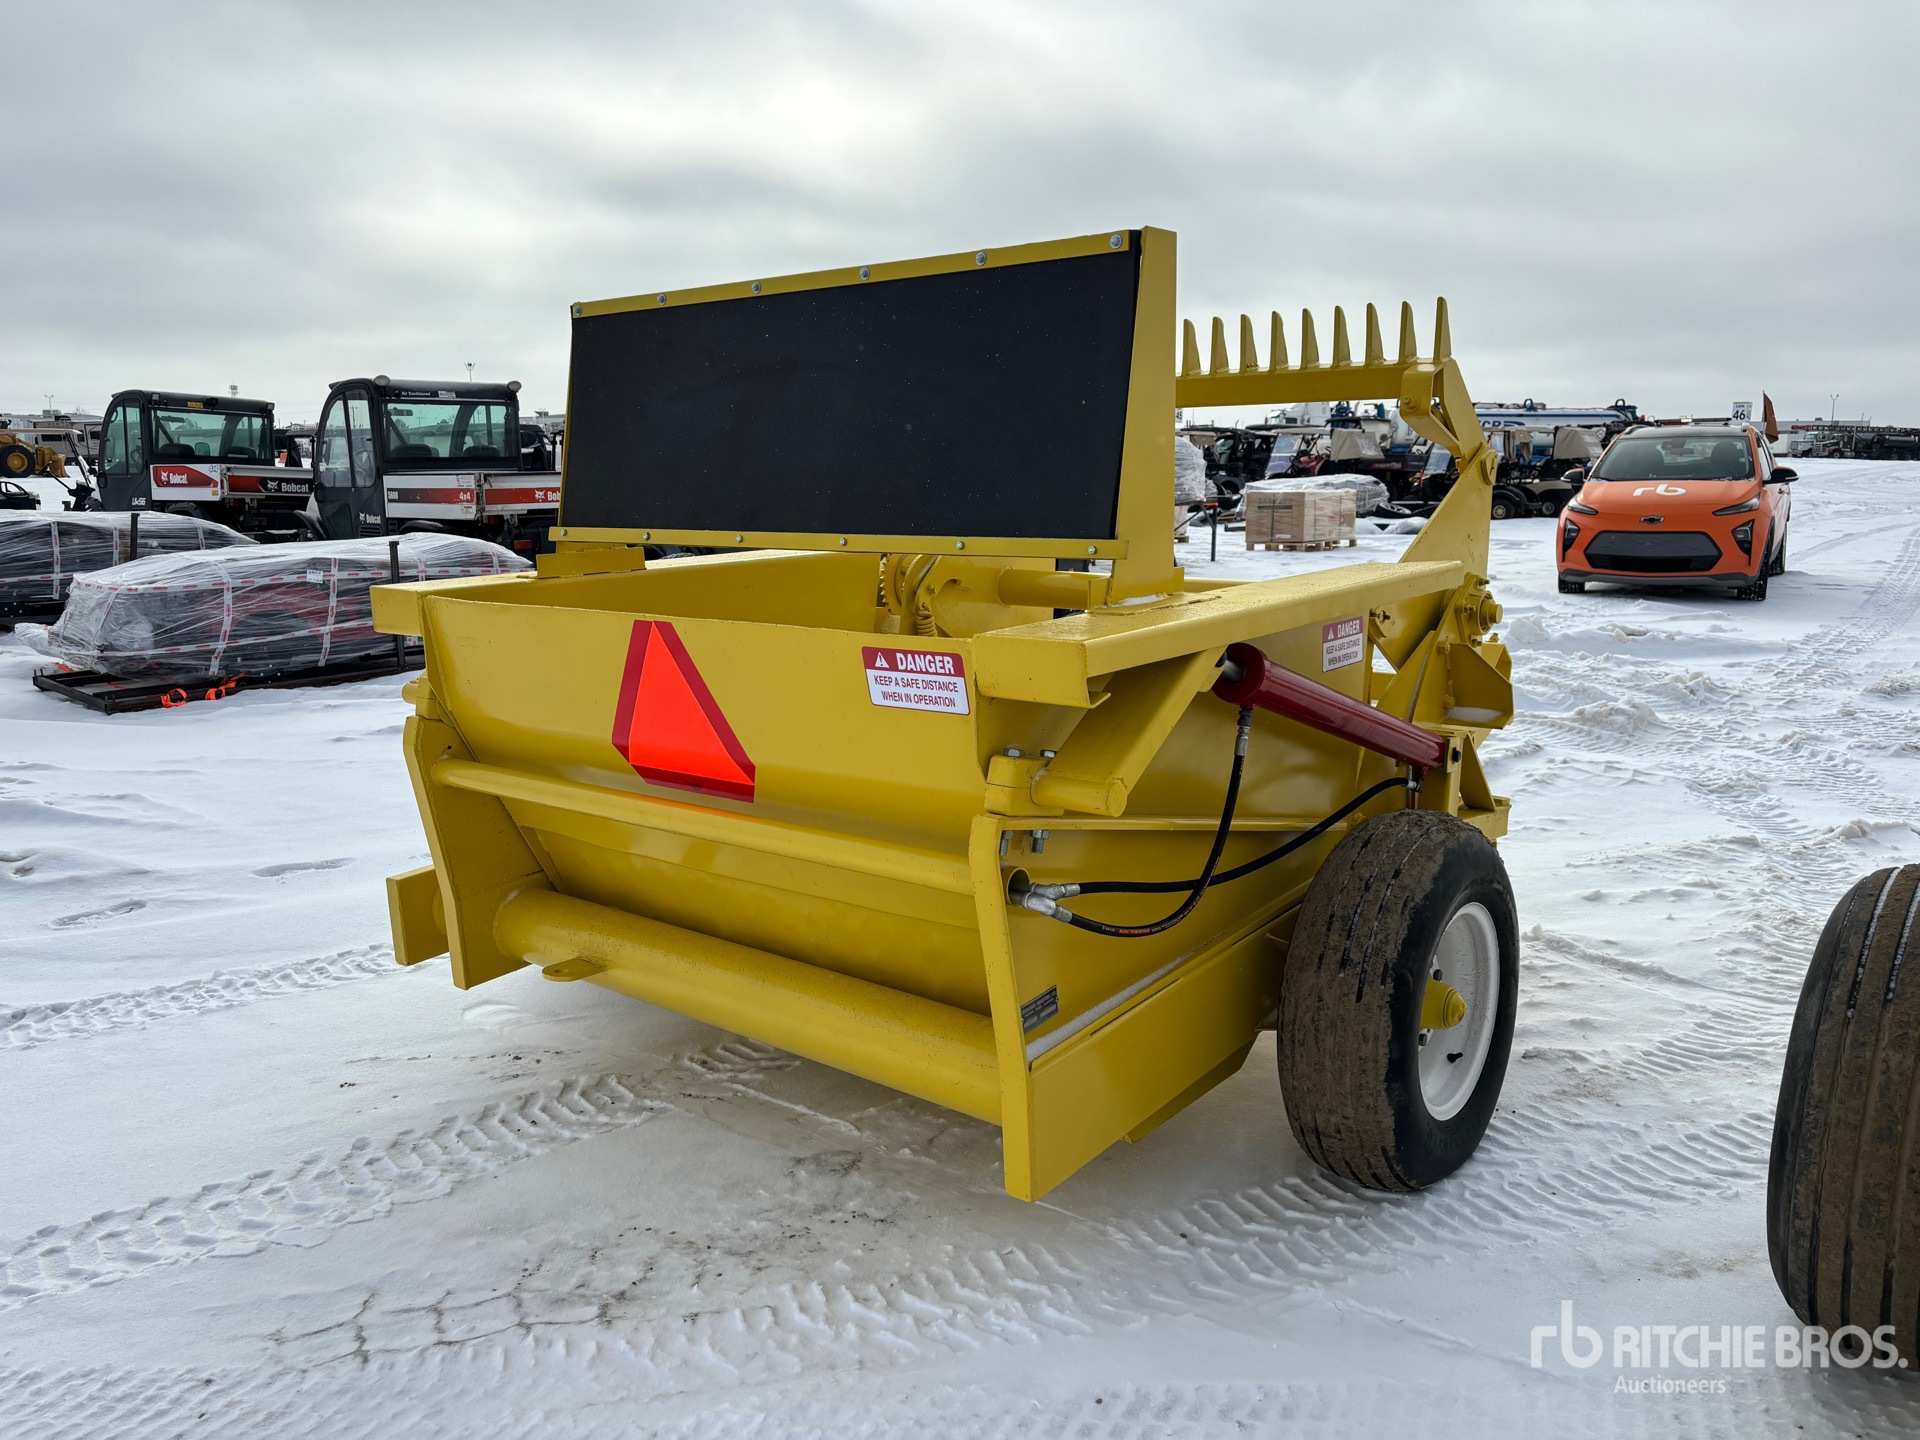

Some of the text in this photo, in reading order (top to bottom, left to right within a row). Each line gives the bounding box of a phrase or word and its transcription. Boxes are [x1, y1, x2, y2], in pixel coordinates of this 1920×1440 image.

[1733, 409, 1745, 420] 46
[169, 473, 188, 484] Bobcat
[281, 482, 309, 493] Bobcat
[1632, 483, 1687, 497] rb
[459, 491, 471, 501] 4x4
[366, 513, 381, 524] Bobcat
[1338, 620, 1360, 638] DANGER
[895, 652, 955, 675] DANGER
[874, 675, 959, 692] KEEP A SAFE DISTANCE
[881, 690, 956, 708] WHEN IN OPERATION
